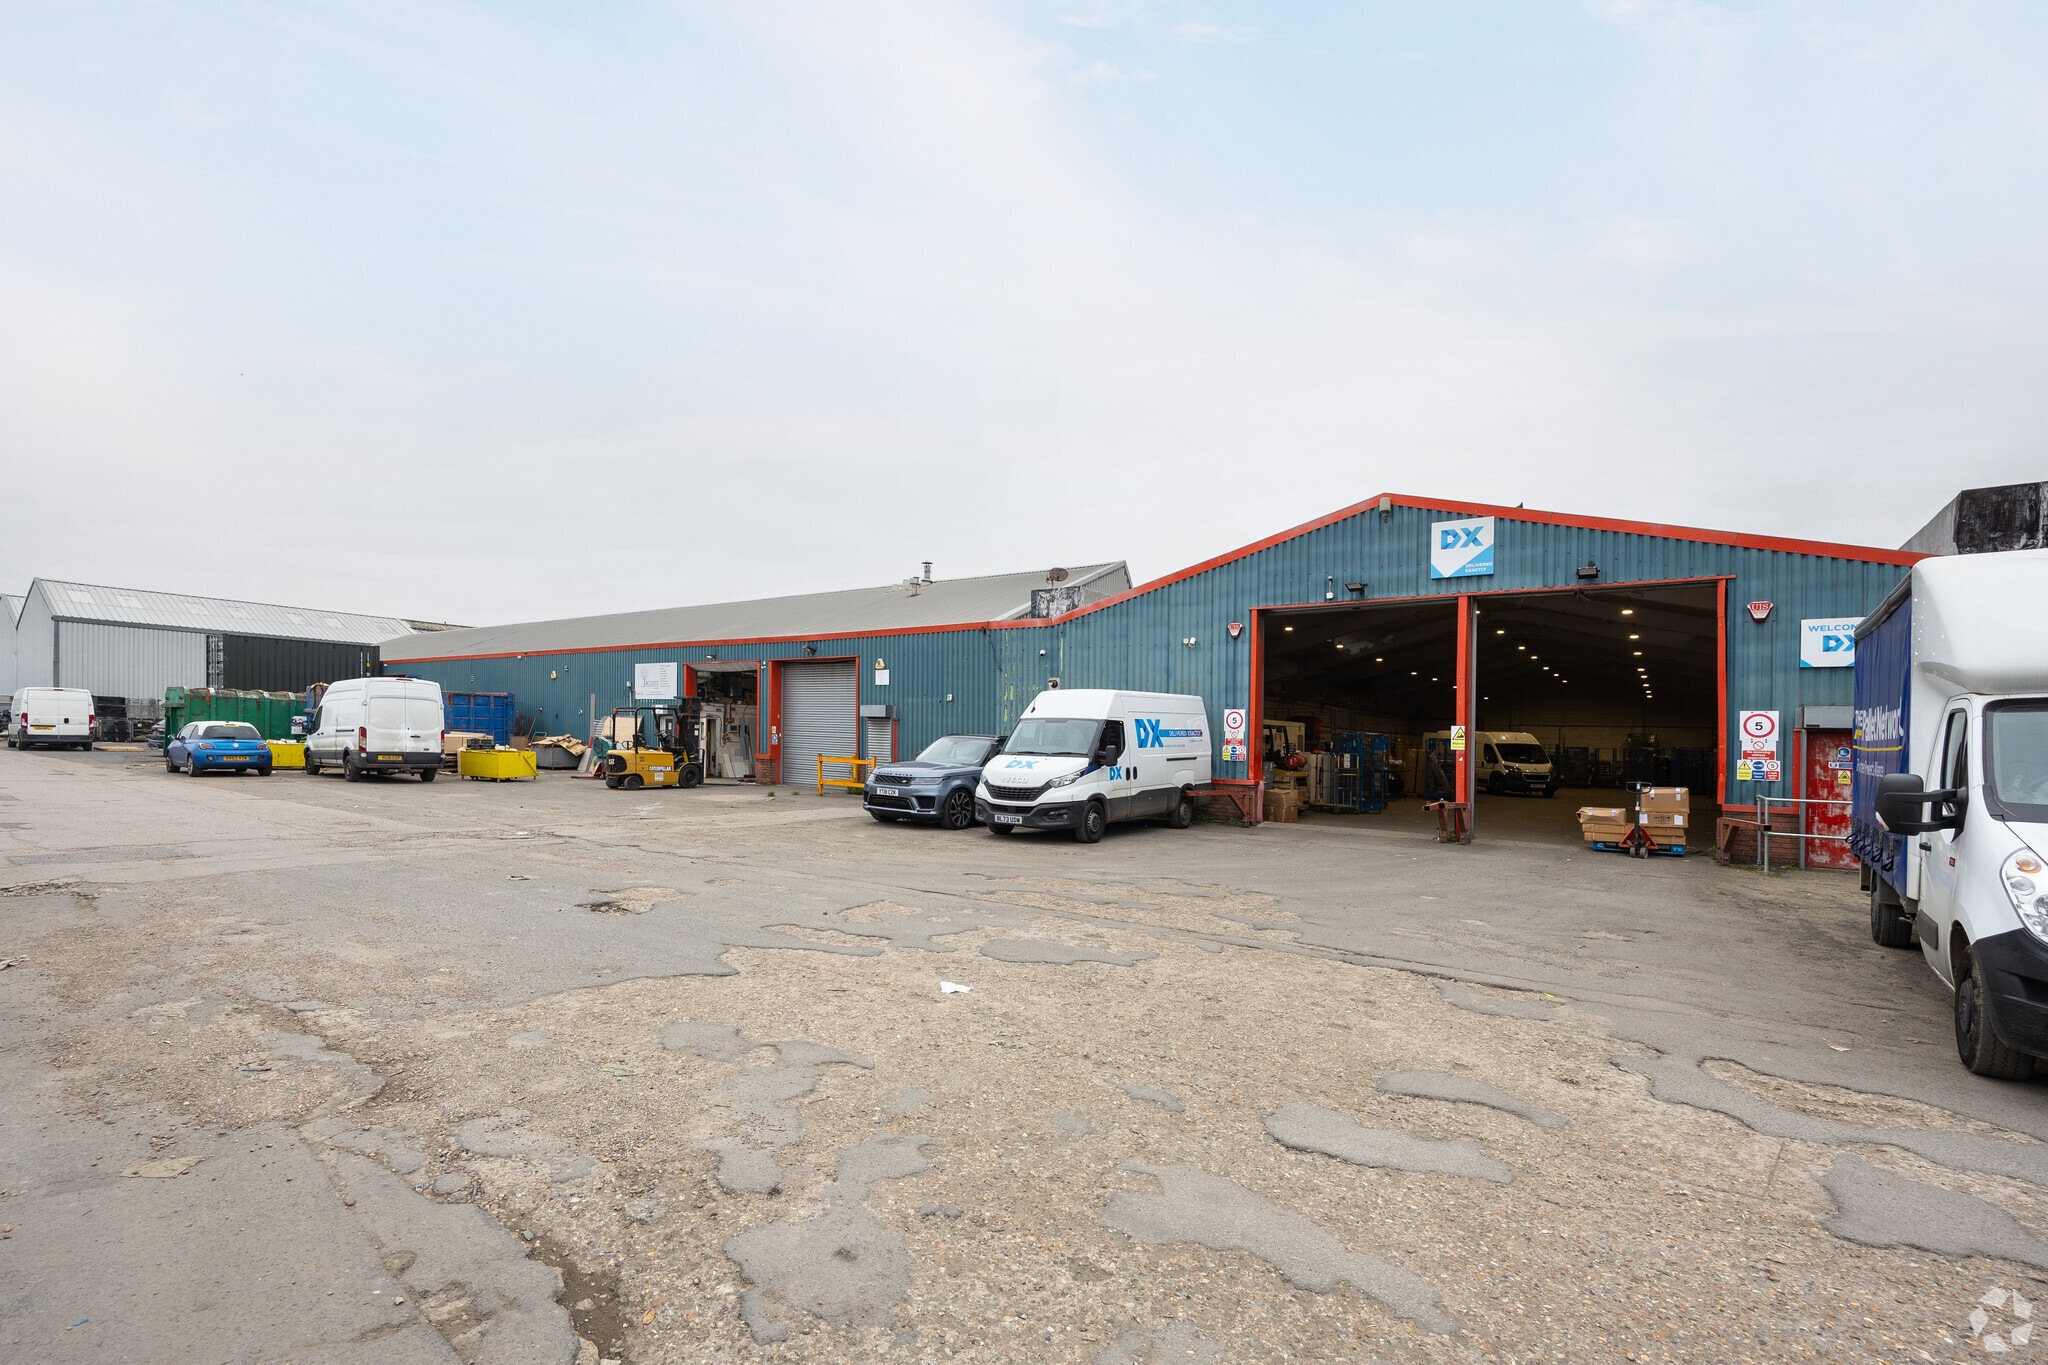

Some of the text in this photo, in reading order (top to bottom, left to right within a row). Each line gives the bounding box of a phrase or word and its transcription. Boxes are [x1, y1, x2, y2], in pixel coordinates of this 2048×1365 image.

[1441, 526, 1484, 550] DX
[1808, 624, 1858, 632] WELCO
[1755, 722, 1763, 730] 5
[1134, 719, 1164, 748] DX
[1004, 760, 1040, 769] DX
[1110, 766, 1122, 780] DX
